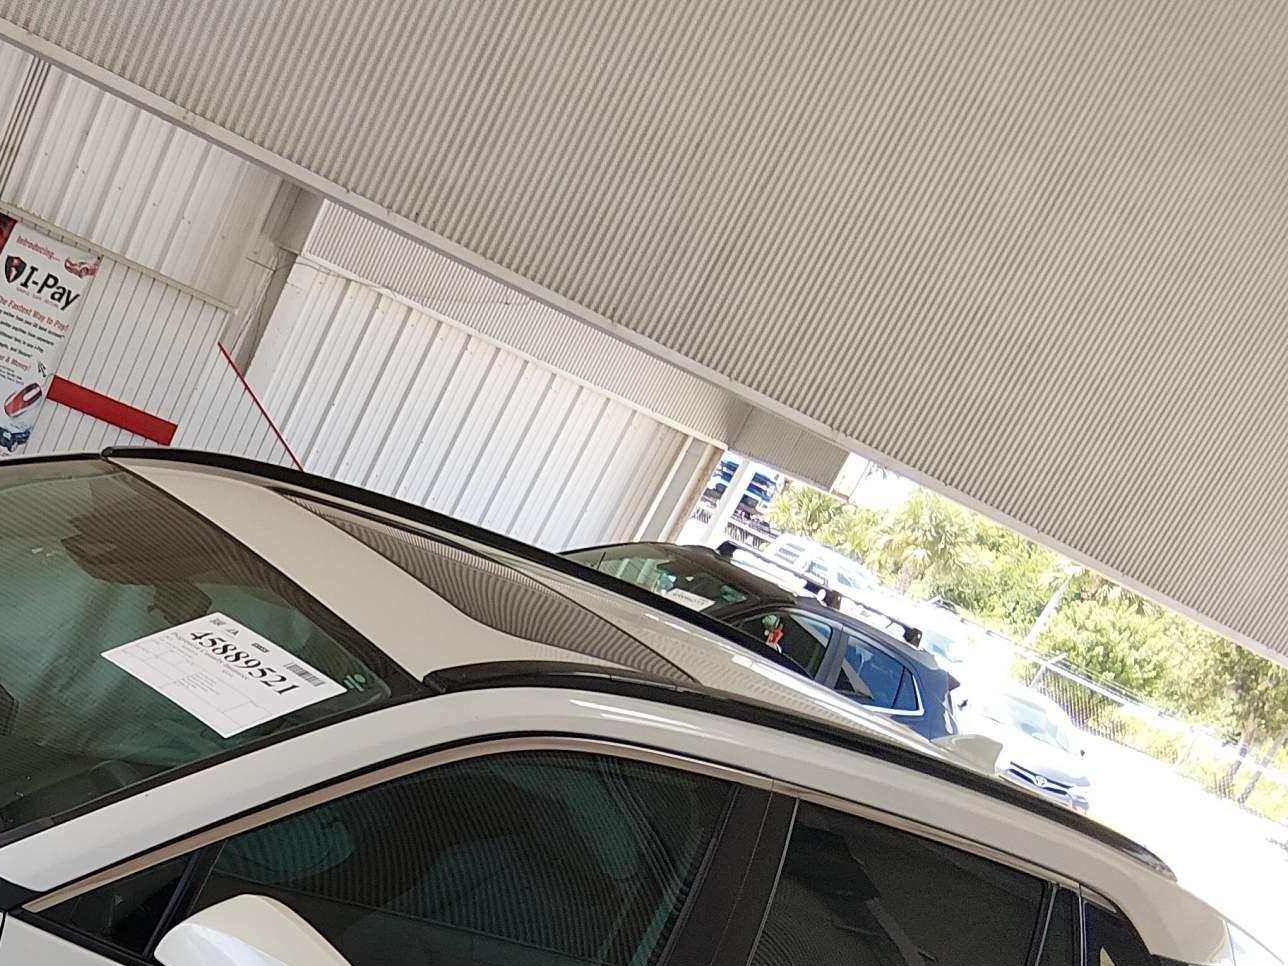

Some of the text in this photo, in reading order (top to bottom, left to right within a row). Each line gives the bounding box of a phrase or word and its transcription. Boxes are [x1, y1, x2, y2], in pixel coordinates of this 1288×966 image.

[8, 300, 32, 316] Fastest
[19, 265, 81, 311] I-Pay
[190, 631, 301, 696] 45889521
